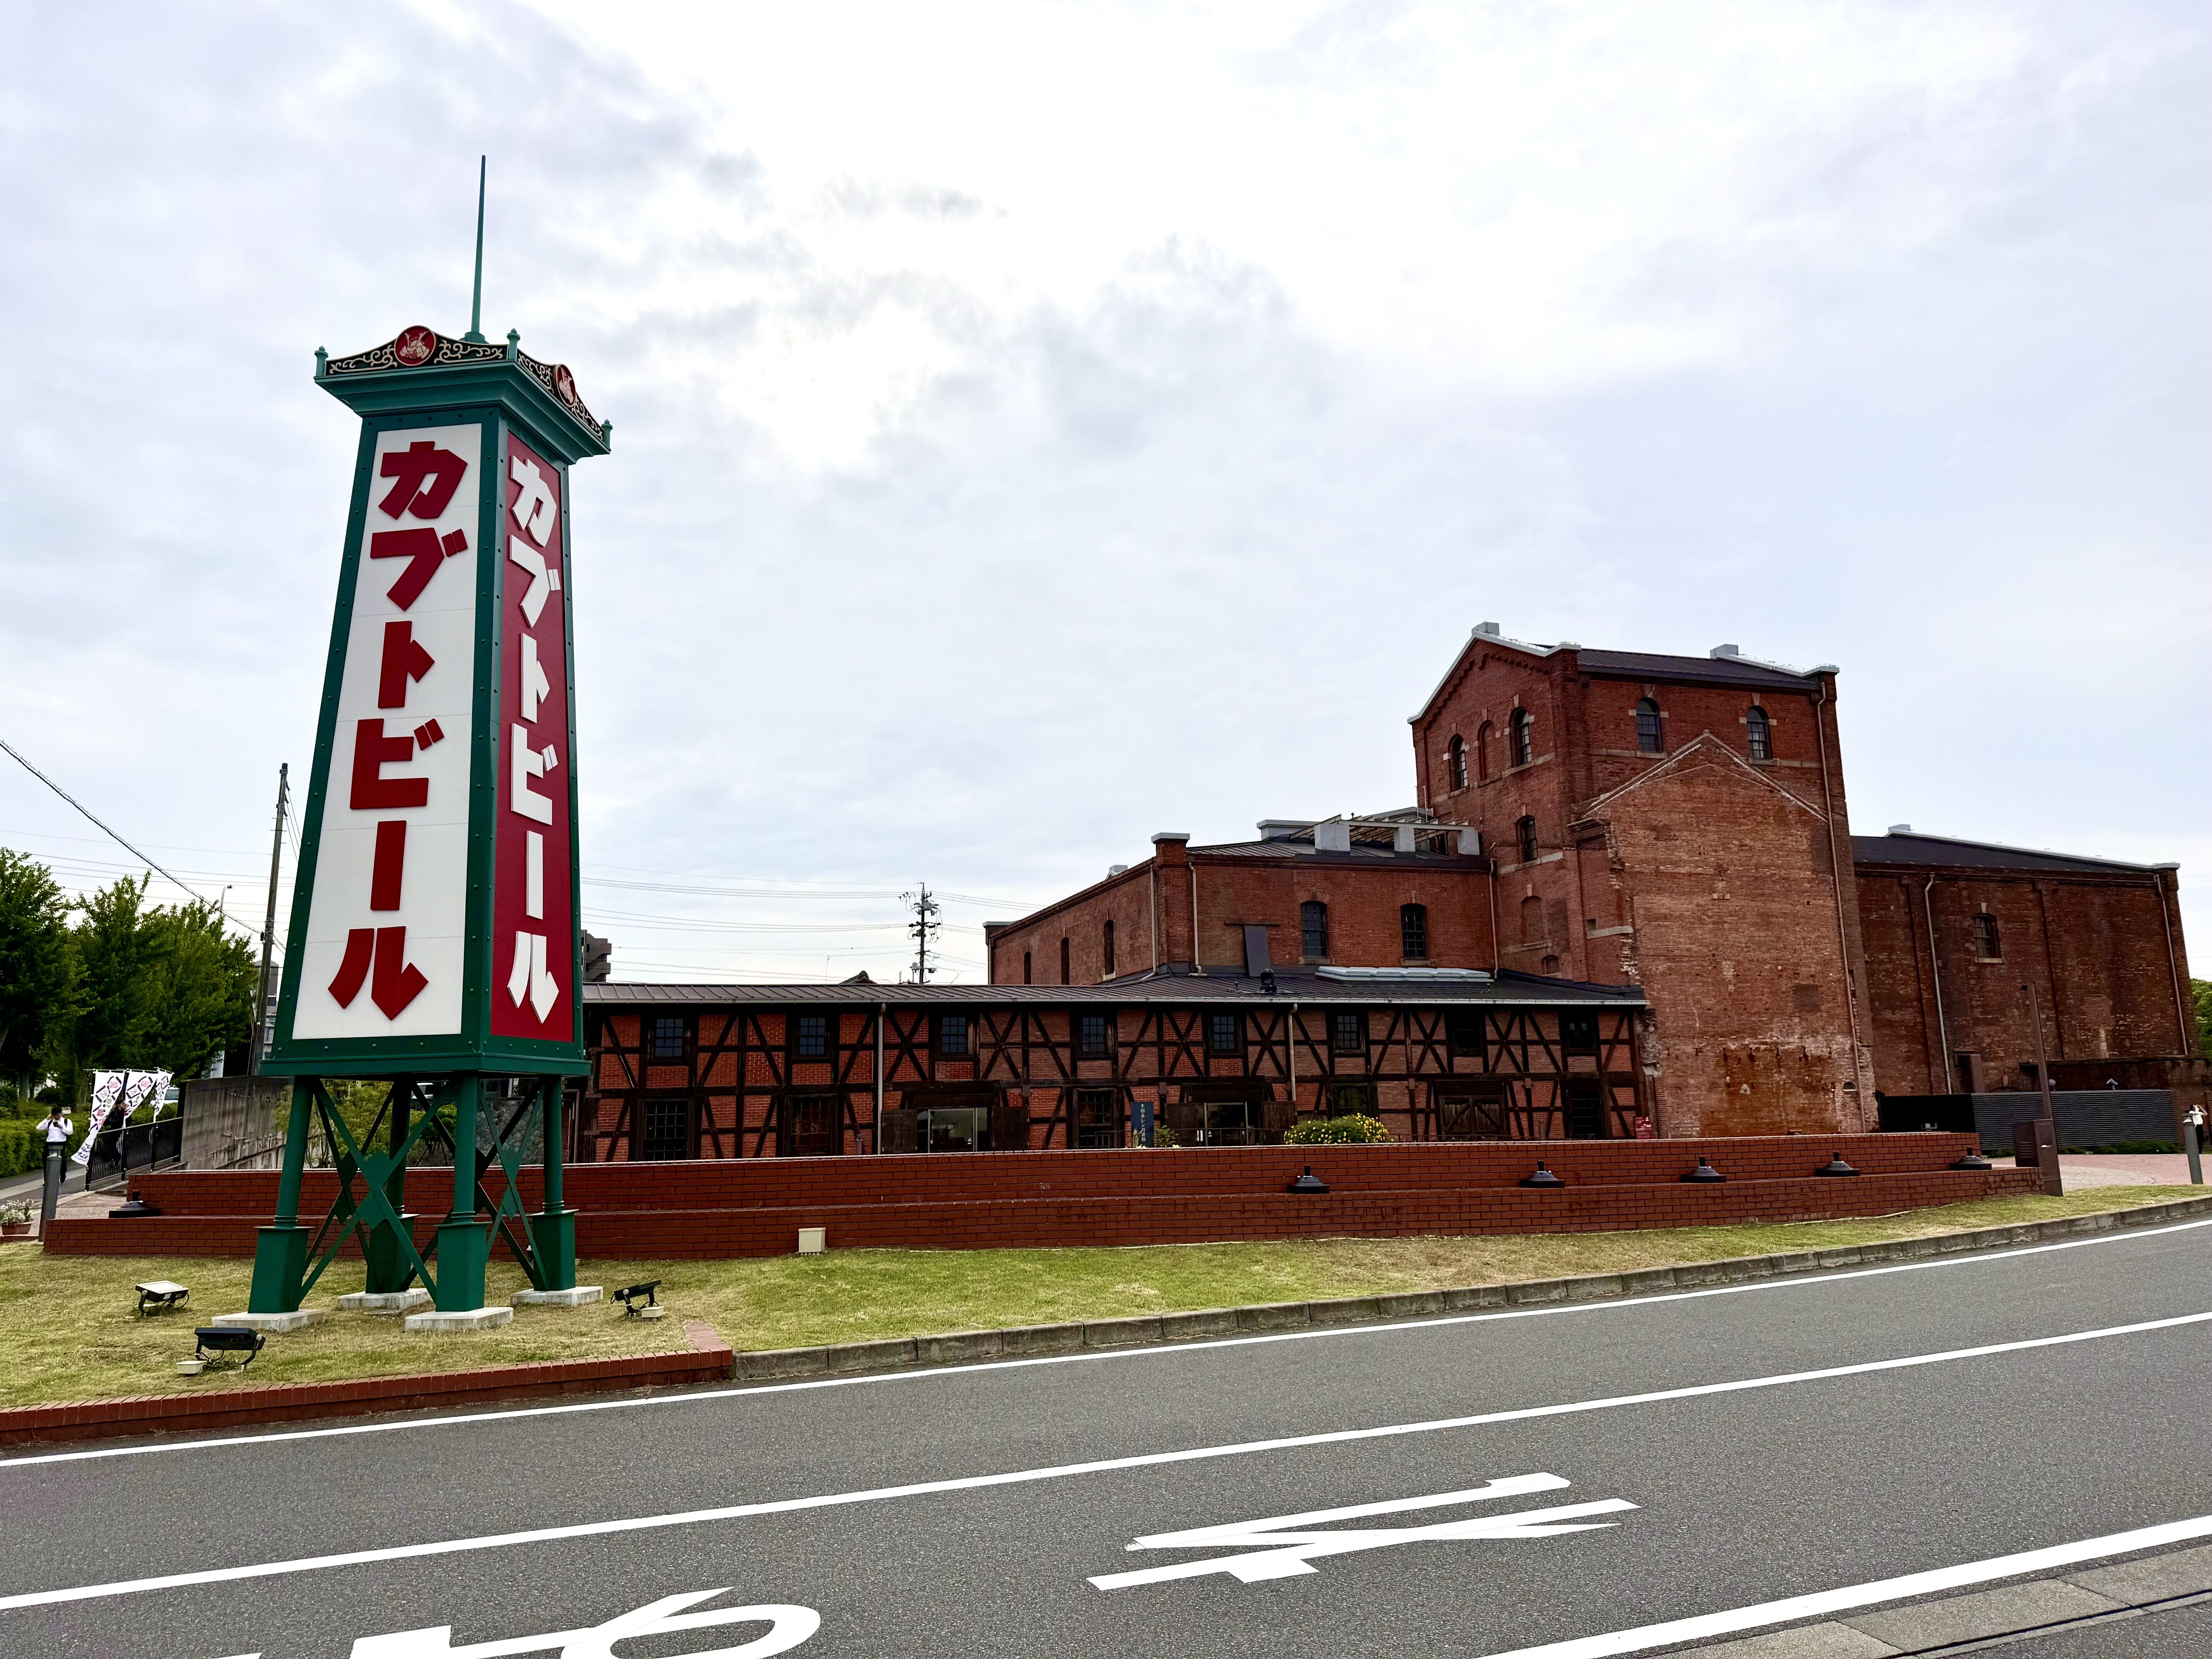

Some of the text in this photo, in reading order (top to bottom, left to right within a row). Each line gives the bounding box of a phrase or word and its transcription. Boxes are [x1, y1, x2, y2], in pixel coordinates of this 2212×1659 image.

[327, 441, 468, 1020] カブトビール
[507, 455, 561, 1024] カブトビール
